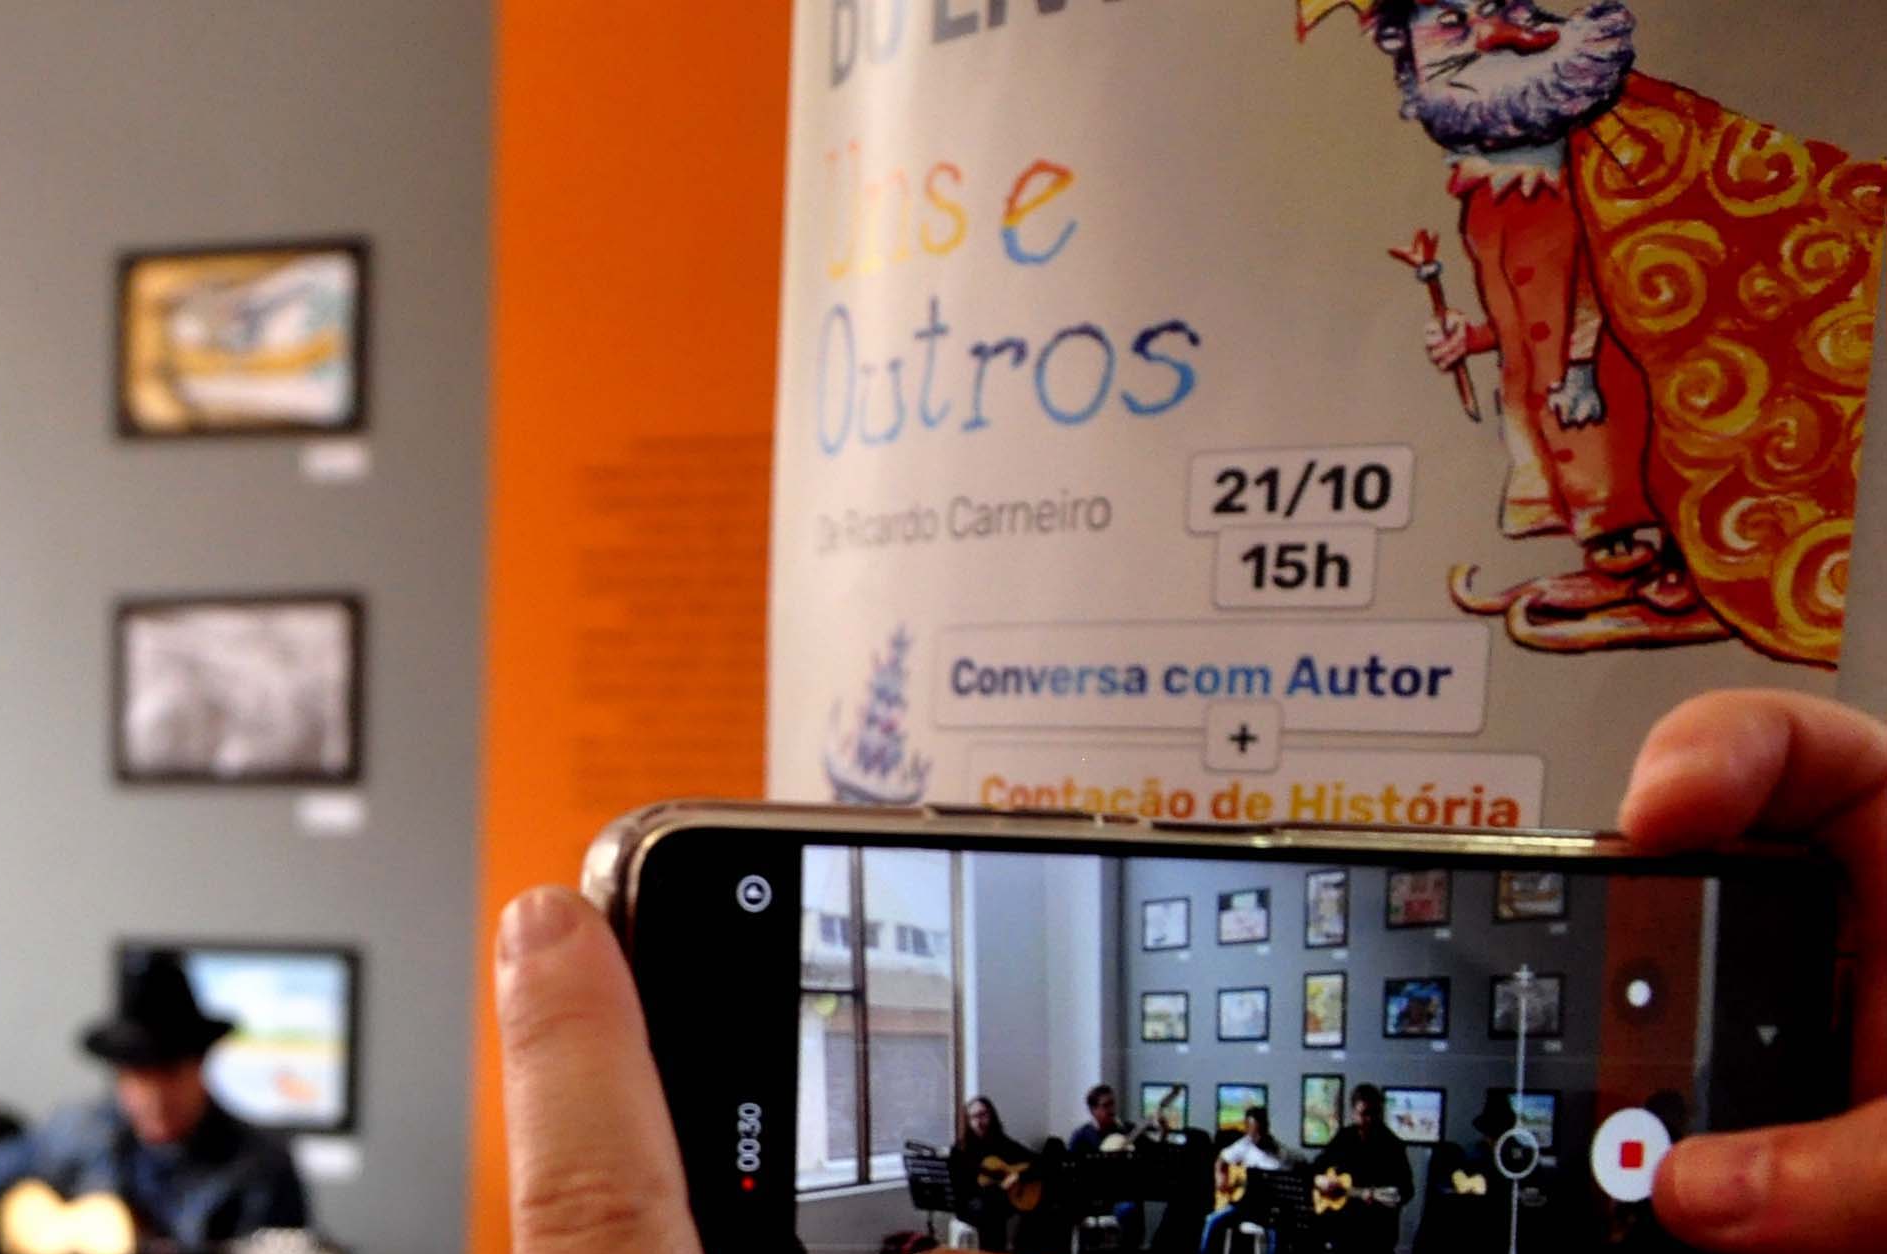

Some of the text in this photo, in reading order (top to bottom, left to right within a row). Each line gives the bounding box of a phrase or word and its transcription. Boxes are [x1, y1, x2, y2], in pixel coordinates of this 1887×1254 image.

[1001, 158, 1077, 266] e
[817, 295, 1201, 456] Outros
[947, 487, 1113, 541] Carneiro
[1213, 461, 1391, 517] 21/10
[1241, 542, 1351, 588] 15h
[951, 655, 1452, 697] Conversa com Autor
[1209, 781, 1274, 822] de
[1288, 781, 1520, 828] História
[737, 1102, 762, 1172] 00:30
